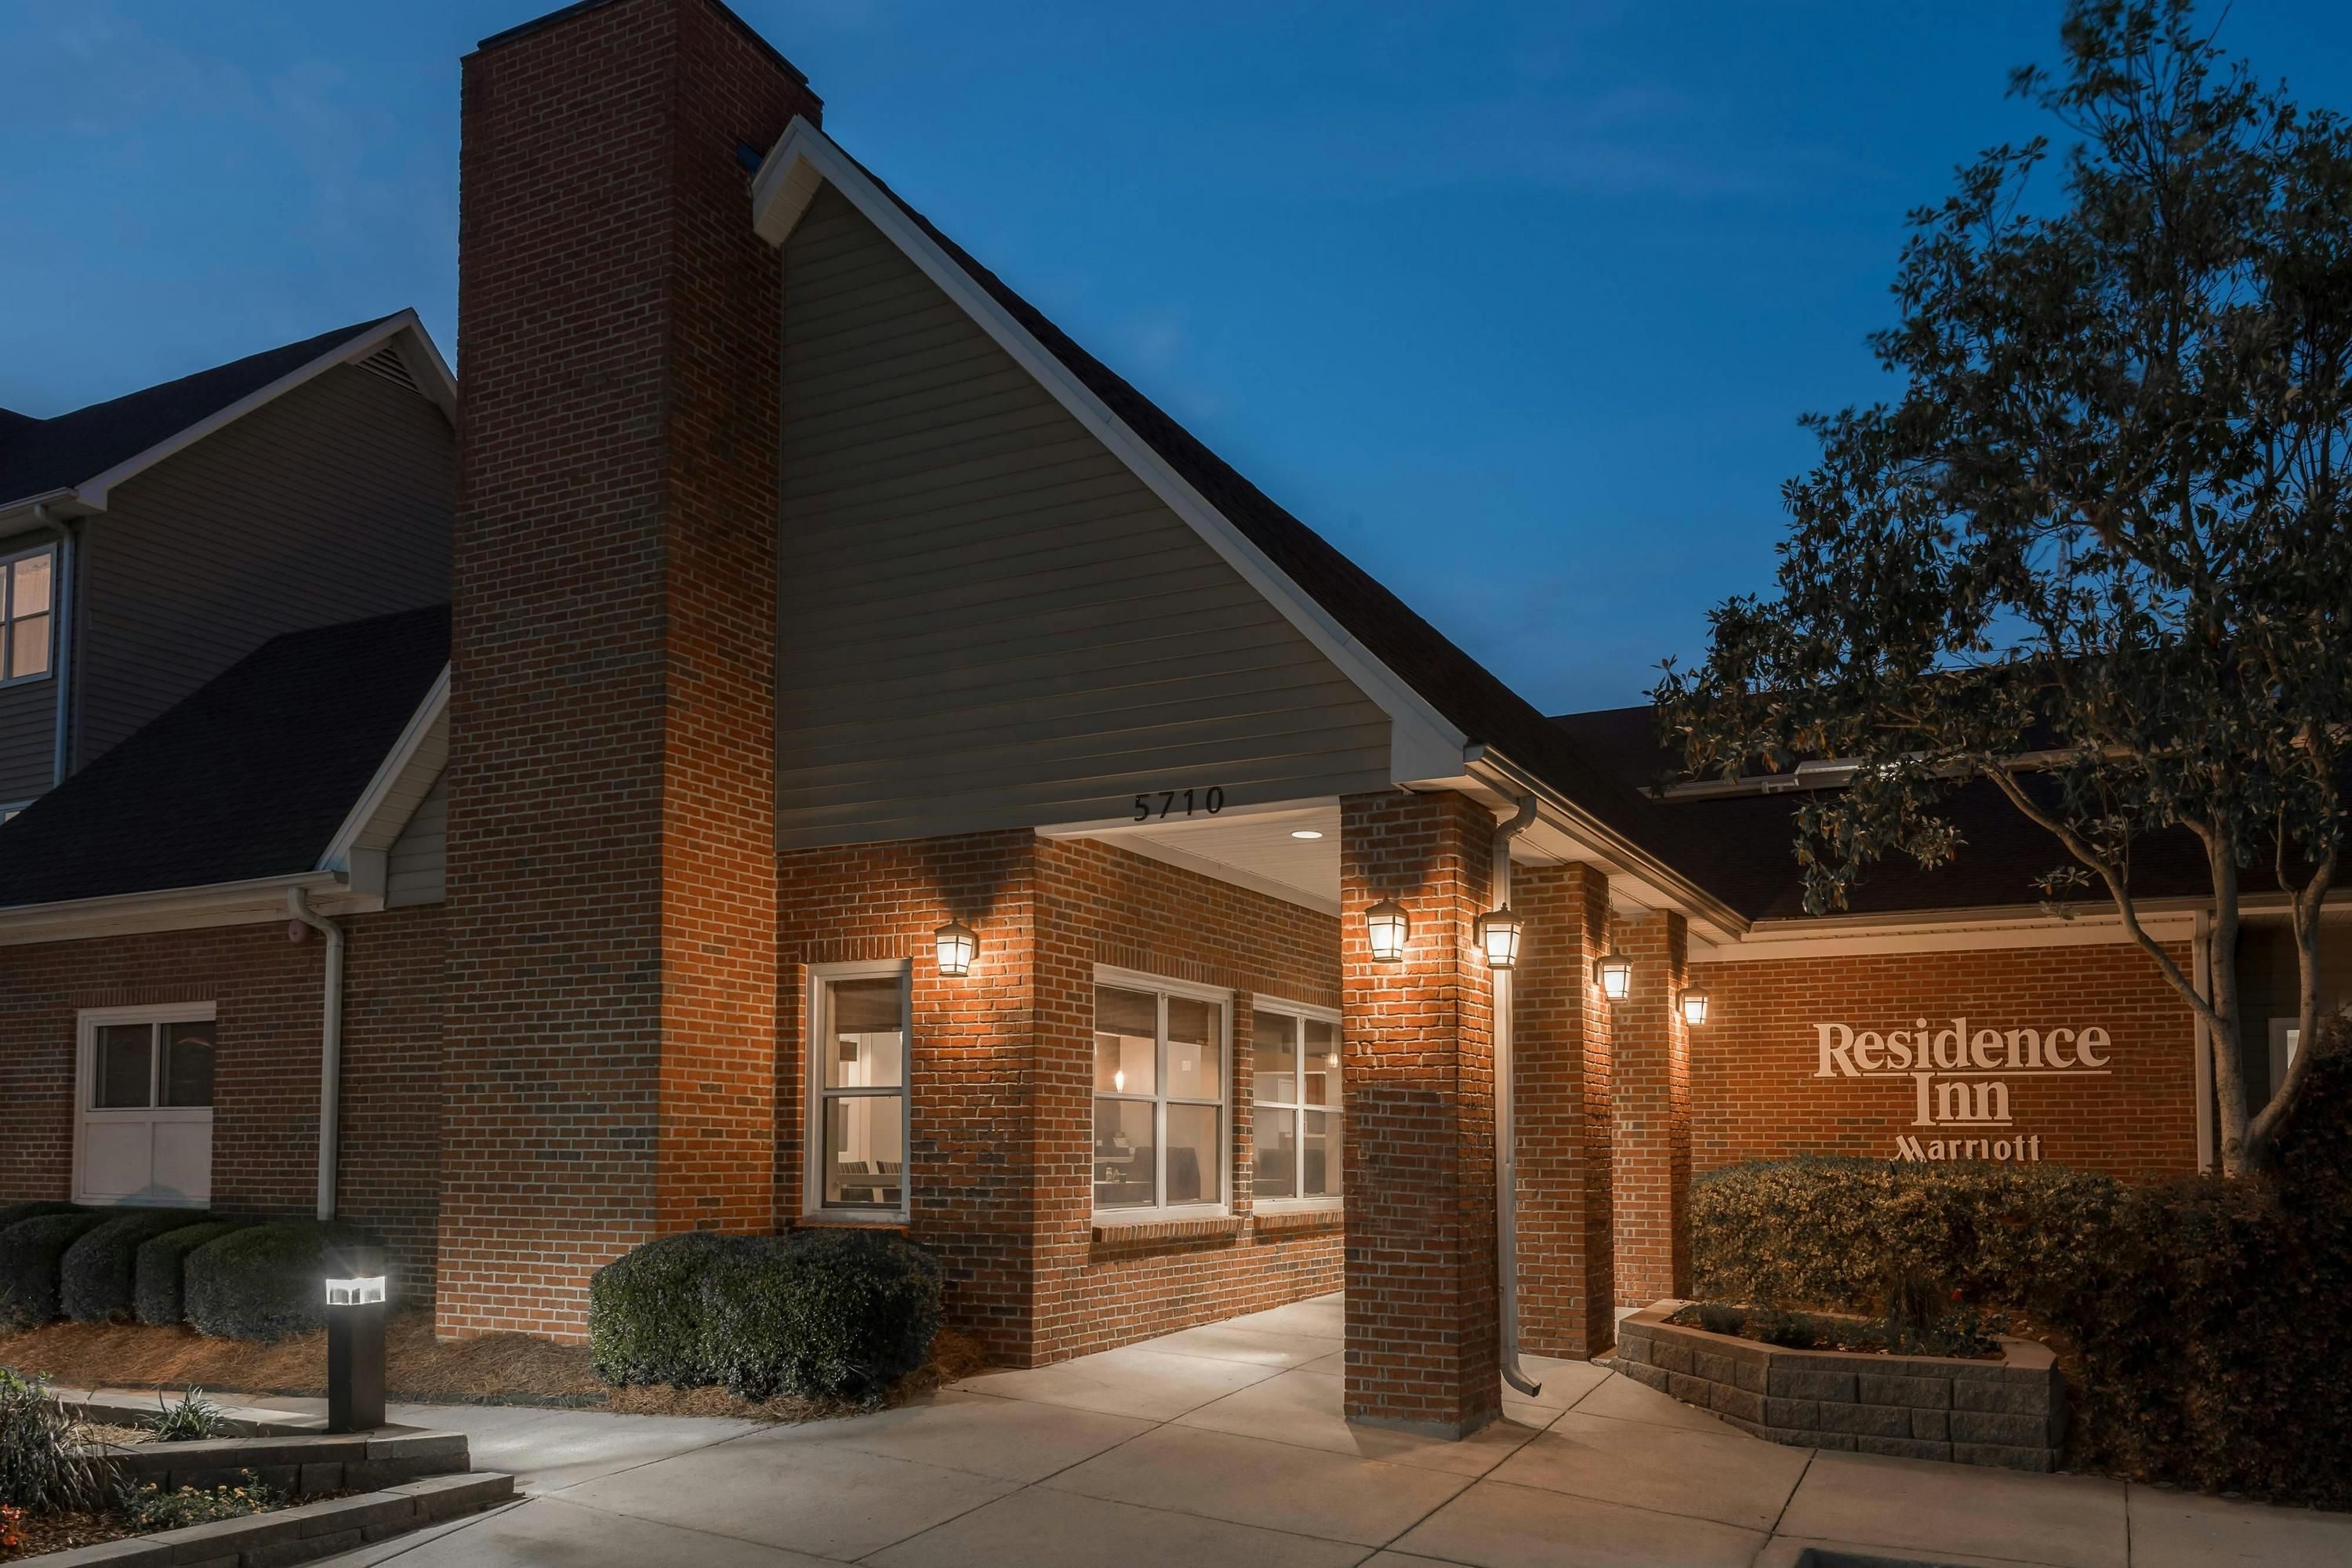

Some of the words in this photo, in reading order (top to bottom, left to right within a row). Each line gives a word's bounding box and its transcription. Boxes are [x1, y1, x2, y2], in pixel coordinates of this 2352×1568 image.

[1134, 786, 1225, 822] 5710
[1813, 1017, 2112, 1078] Residence
[1910, 1072, 2013, 1127] Inn
[1894, 1134, 2041, 1162] Marriott
